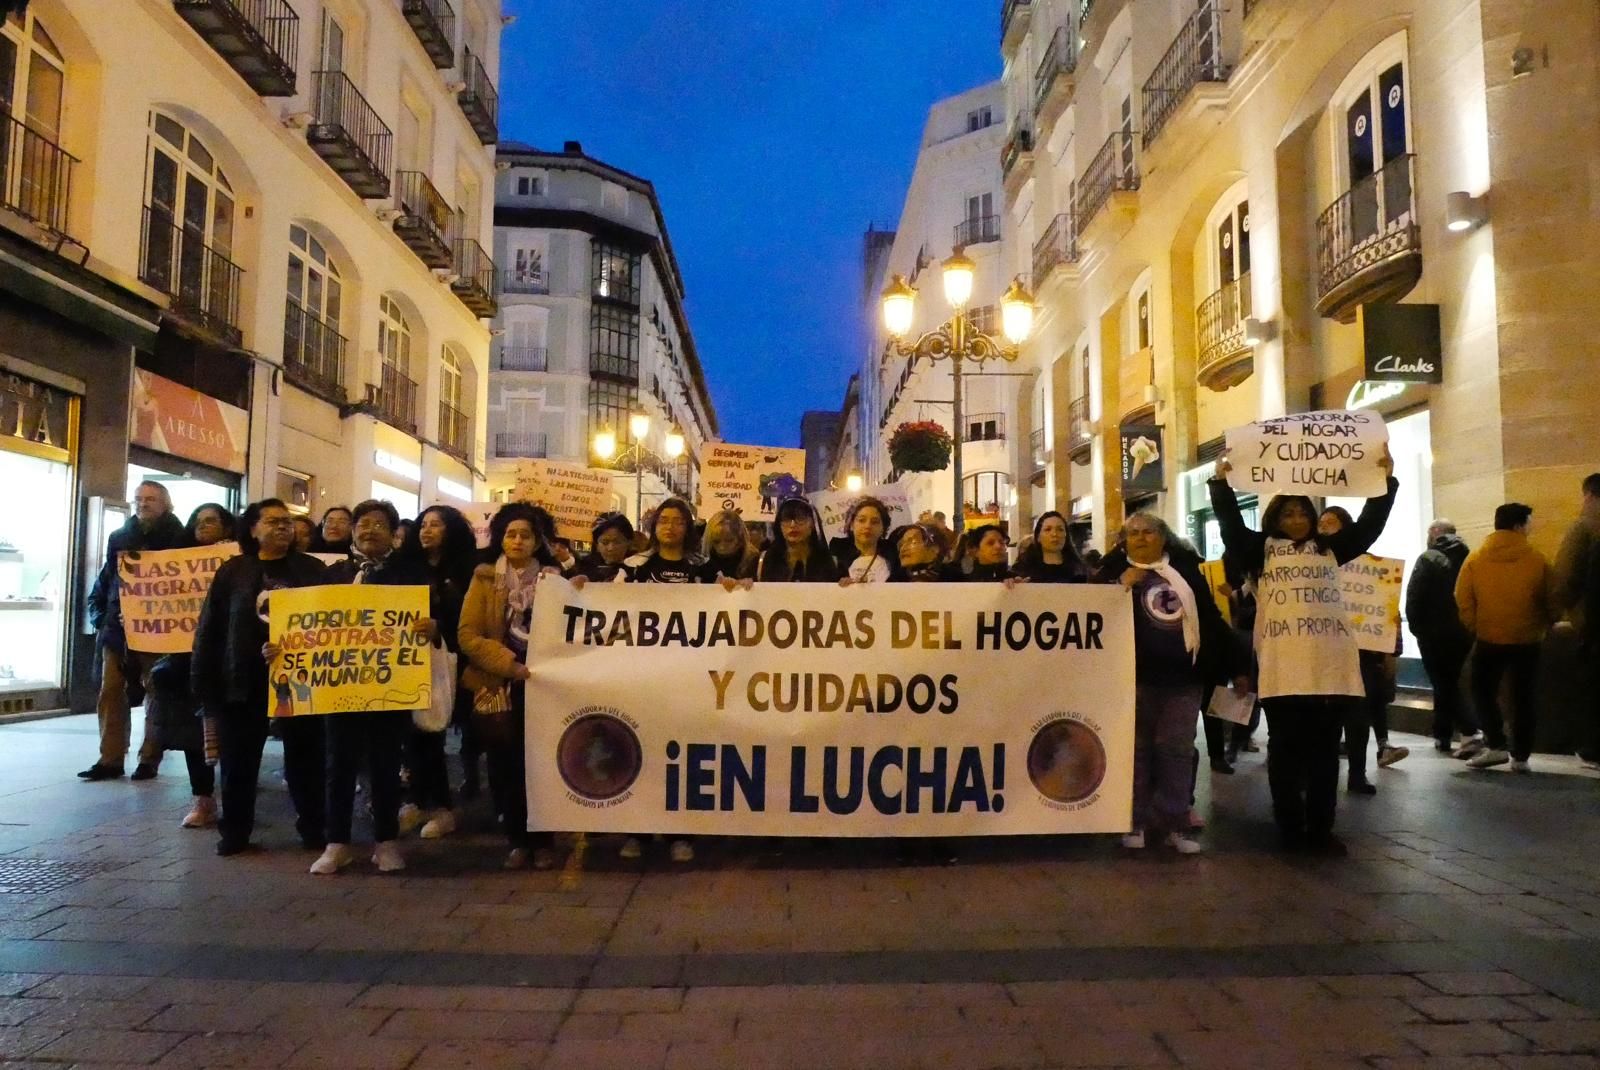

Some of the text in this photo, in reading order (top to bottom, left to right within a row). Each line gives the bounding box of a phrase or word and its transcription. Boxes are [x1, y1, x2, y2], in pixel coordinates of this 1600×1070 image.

[1374, 355, 1435, 373] Clarks
[165, 416, 225, 449] ARESSO
[1258, 423, 1359, 438] DEL HOGAR
[1121, 436, 1129, 480] HELADOS
[1258, 440, 1272, 459] Y
[724, 470, 735, 480] LA
[1251, 466, 1349, 487] EN LUCHA
[133, 555, 232, 578] LAS VID
[1262, 565, 1336, 587] PARROQUIAS
[1267, 587, 1341, 606] YO TENGO
[287, 609, 421, 632] PORQUE SIN
[563, 605, 1104, 652] TRABAJADORAS DEL HOGAR
[1297, 617, 1349, 639] PROPIA
[279, 627, 430, 650] NOSOTRAS NO
[283, 647, 425, 671] SE MUEVE EL
[310, 665, 392, 687] MUNDO
[708, 670, 959, 715] Y CUIDADOS
[665, 740, 1006, 815] ¡EN LUCHA!
